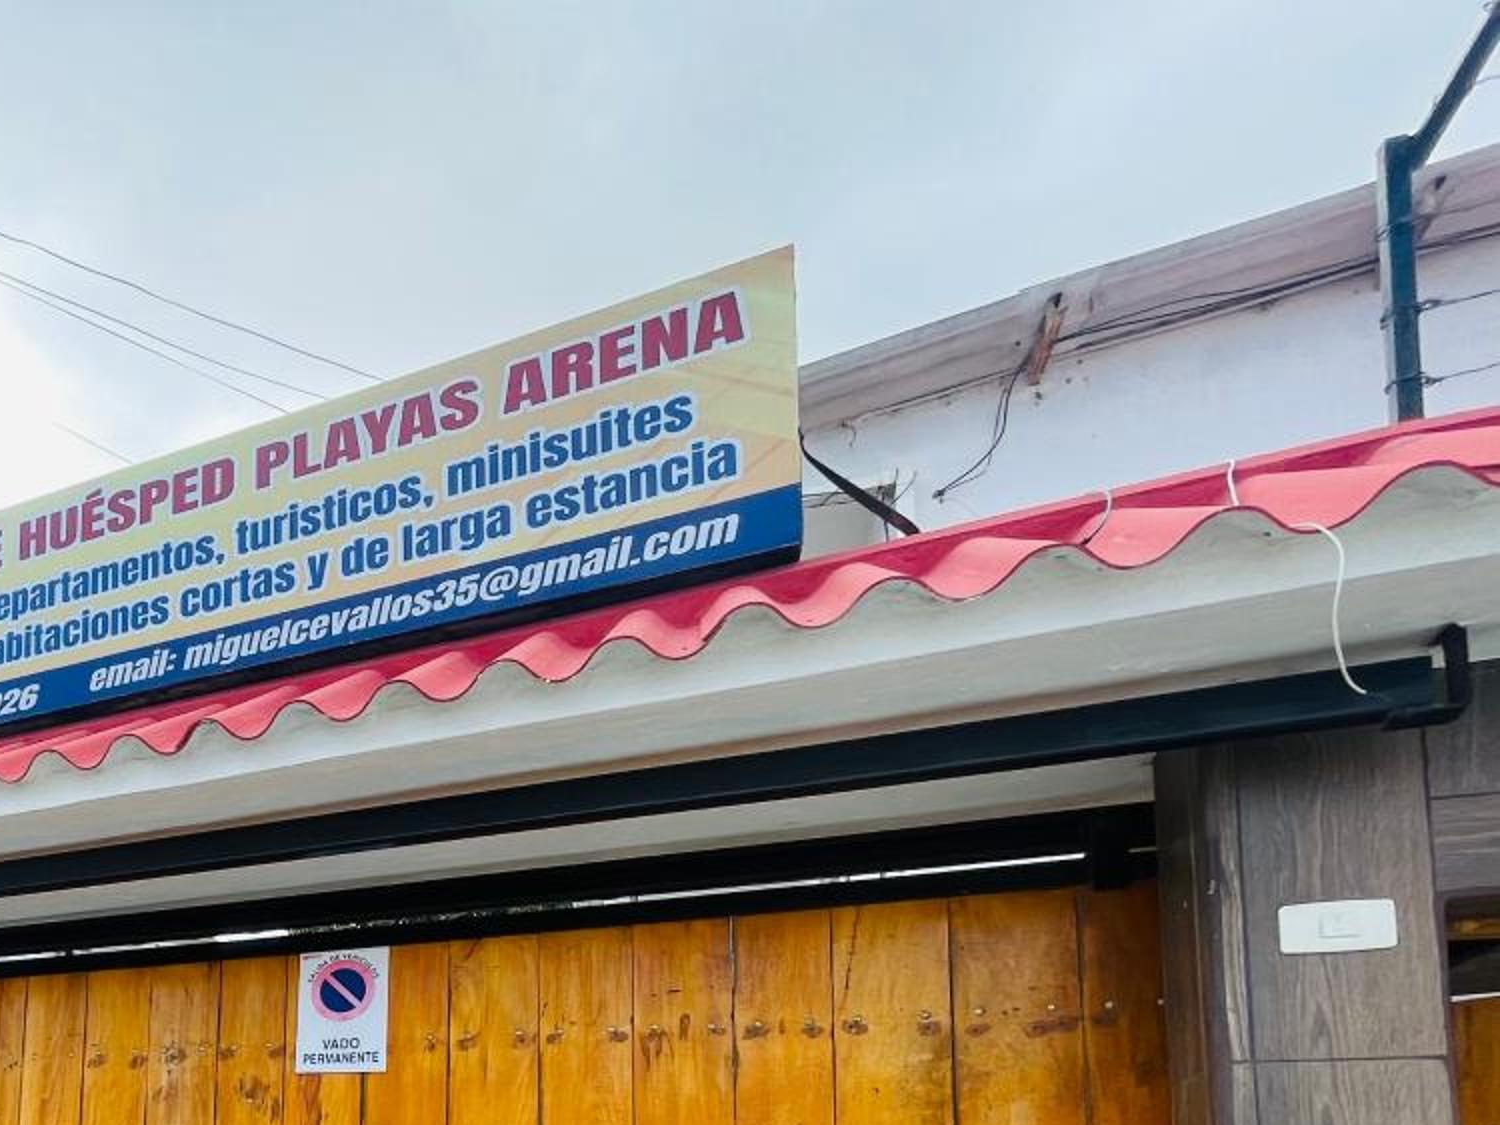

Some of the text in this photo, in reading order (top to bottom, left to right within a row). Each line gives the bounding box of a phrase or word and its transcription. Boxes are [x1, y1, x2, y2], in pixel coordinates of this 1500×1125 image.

[19, 456, 235, 561] HUÉSPED
[255, 380, 480, 489] PLAYAS
[503, 291, 744, 415] ARENA
[237, 475, 433, 555] turisticos,
[446, 395, 693, 497] minisuites
[89, 513, 740, 692] email: miguelcevallos35@gmail.com
[180, 561, 296, 618] cortas
[307, 552, 328, 591] y
[341, 536, 389, 577] de
[403, 504, 512, 562] larga
[526, 441, 738, 528] estancia
[303, 1051, 380, 1065] PERMANENTE
